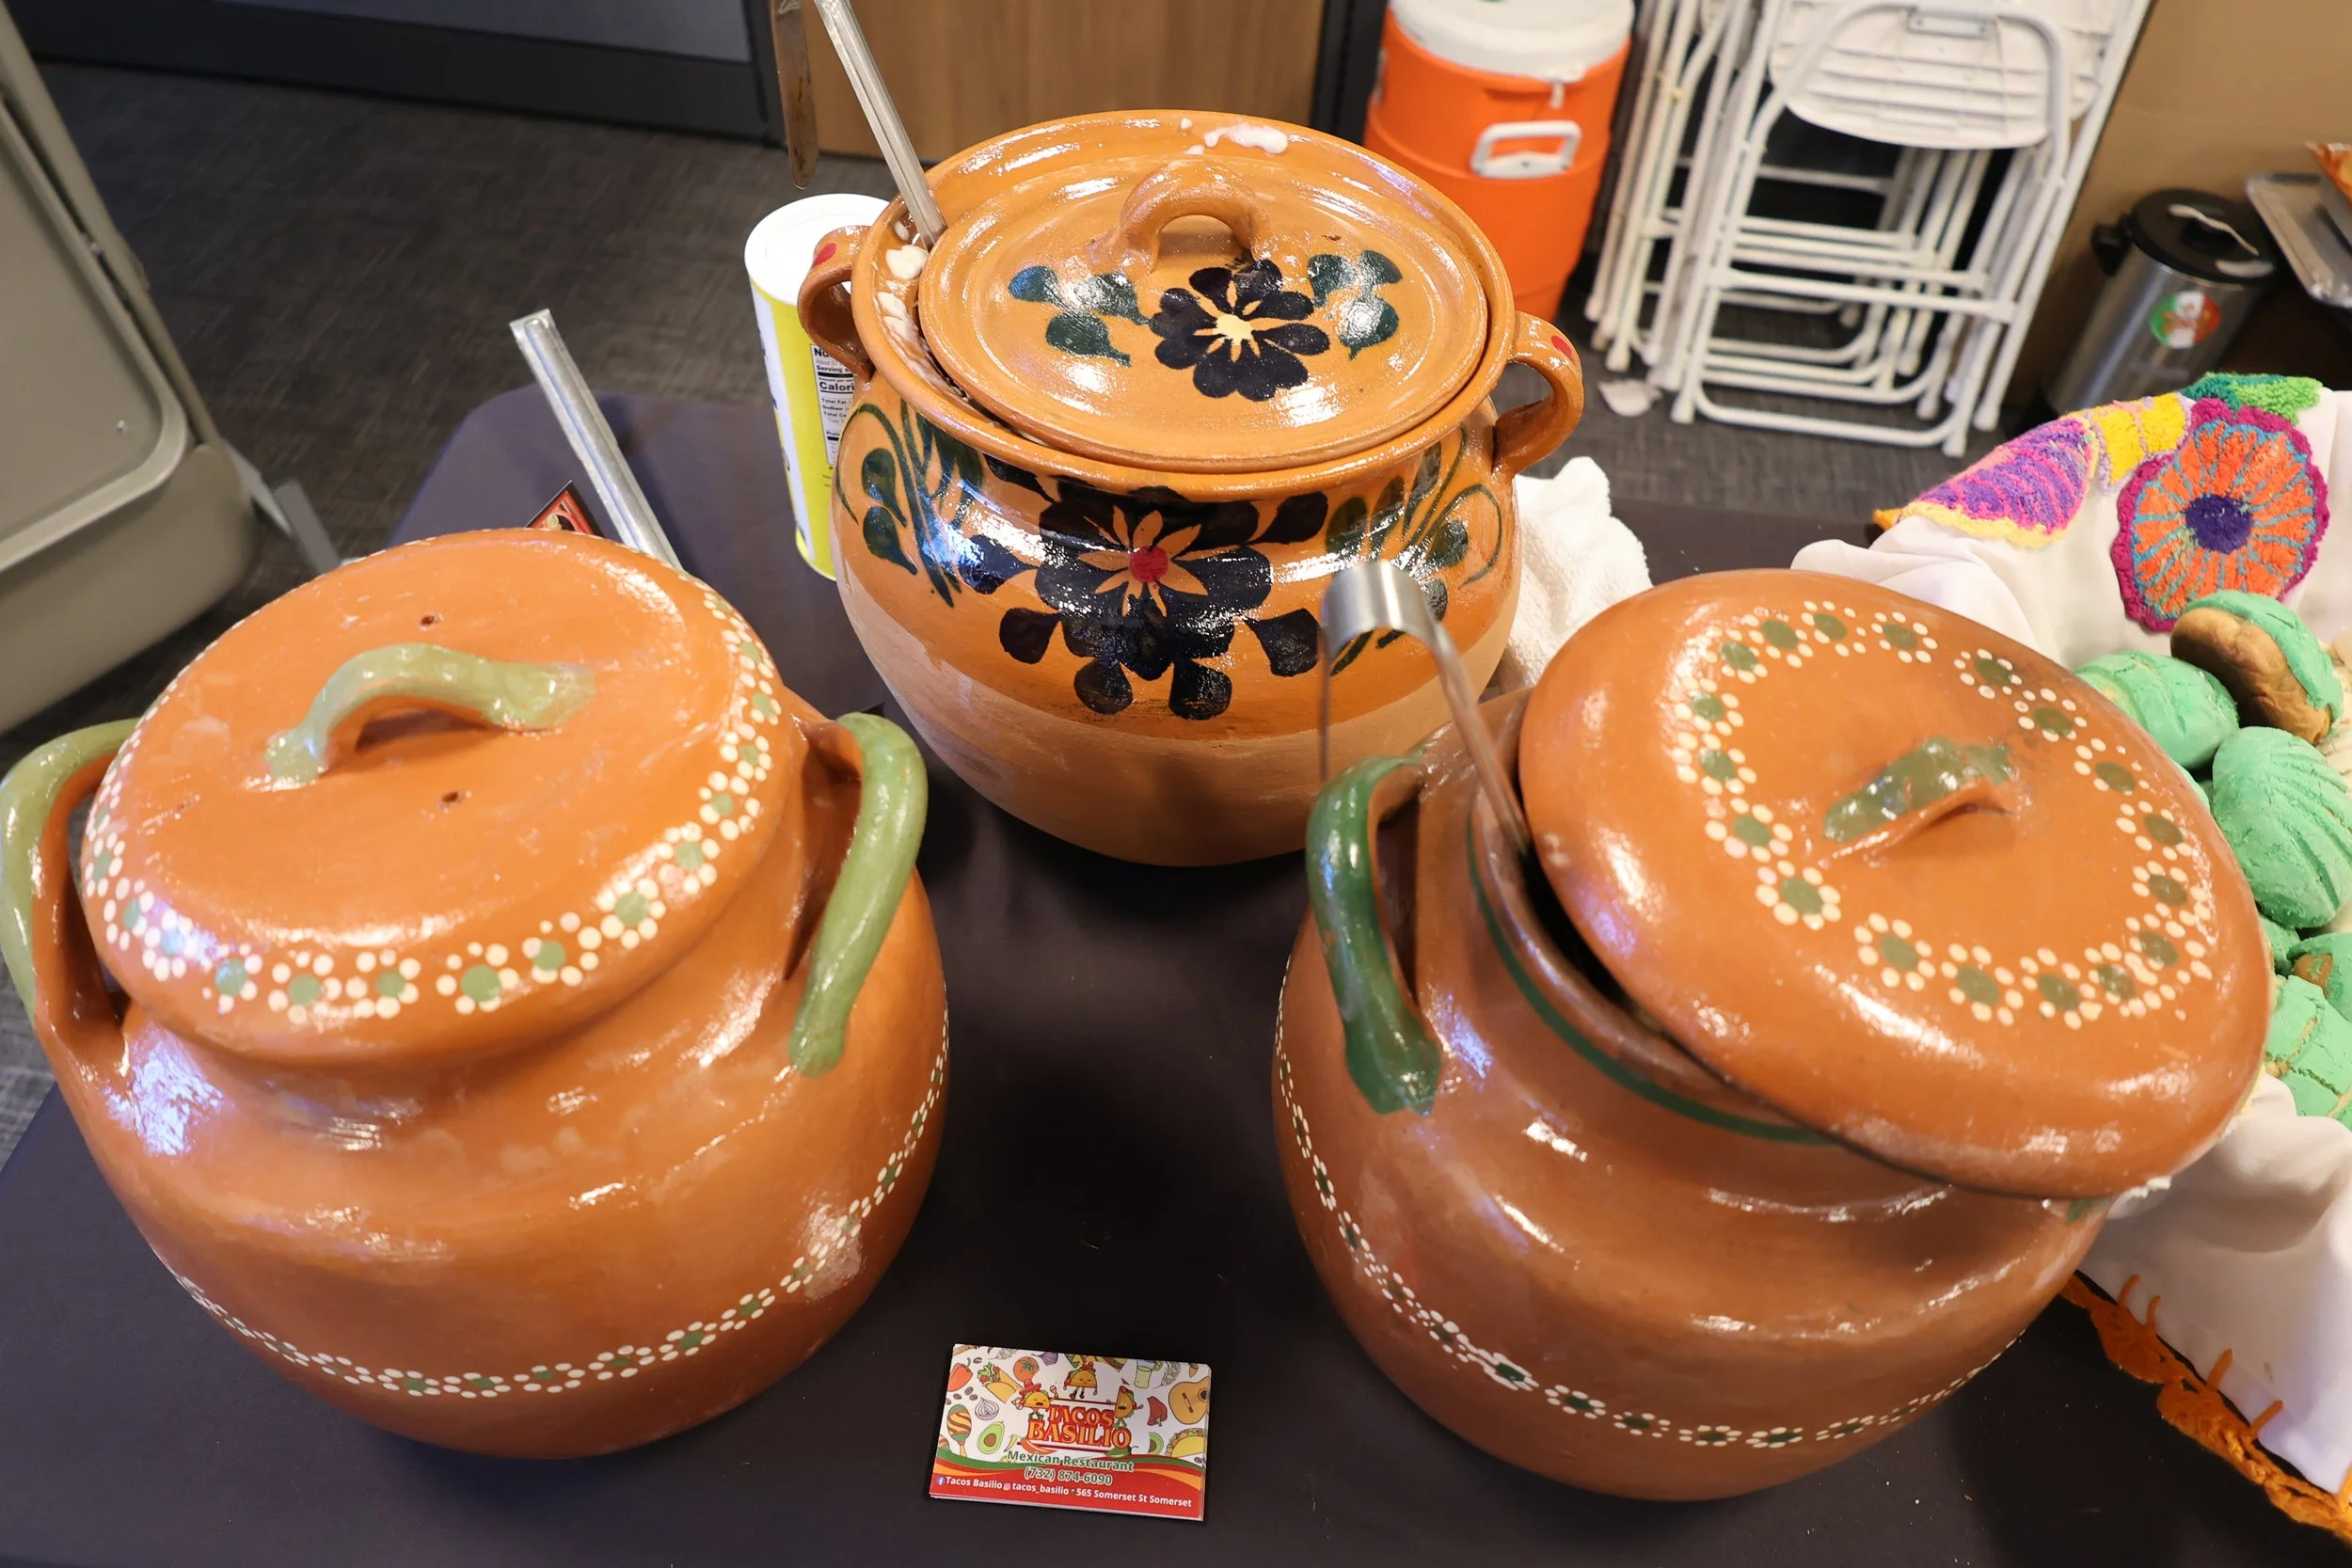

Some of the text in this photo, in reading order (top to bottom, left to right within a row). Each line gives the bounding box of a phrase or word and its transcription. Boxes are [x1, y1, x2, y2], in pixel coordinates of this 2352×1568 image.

[819, 382, 854, 391] Calori
[1048, 1406, 1115, 1428] TACOS
[1027, 1419, 1132, 1449] BASILIO
[1008, 1450, 1134, 1472] Mexican Restaurant
[1025, 1466, 1113, 1485] (732) 874-6090
[946, 1477, 1192, 1507] Tacos Basilio tacos_basilio 565 Somerset St Somerset
